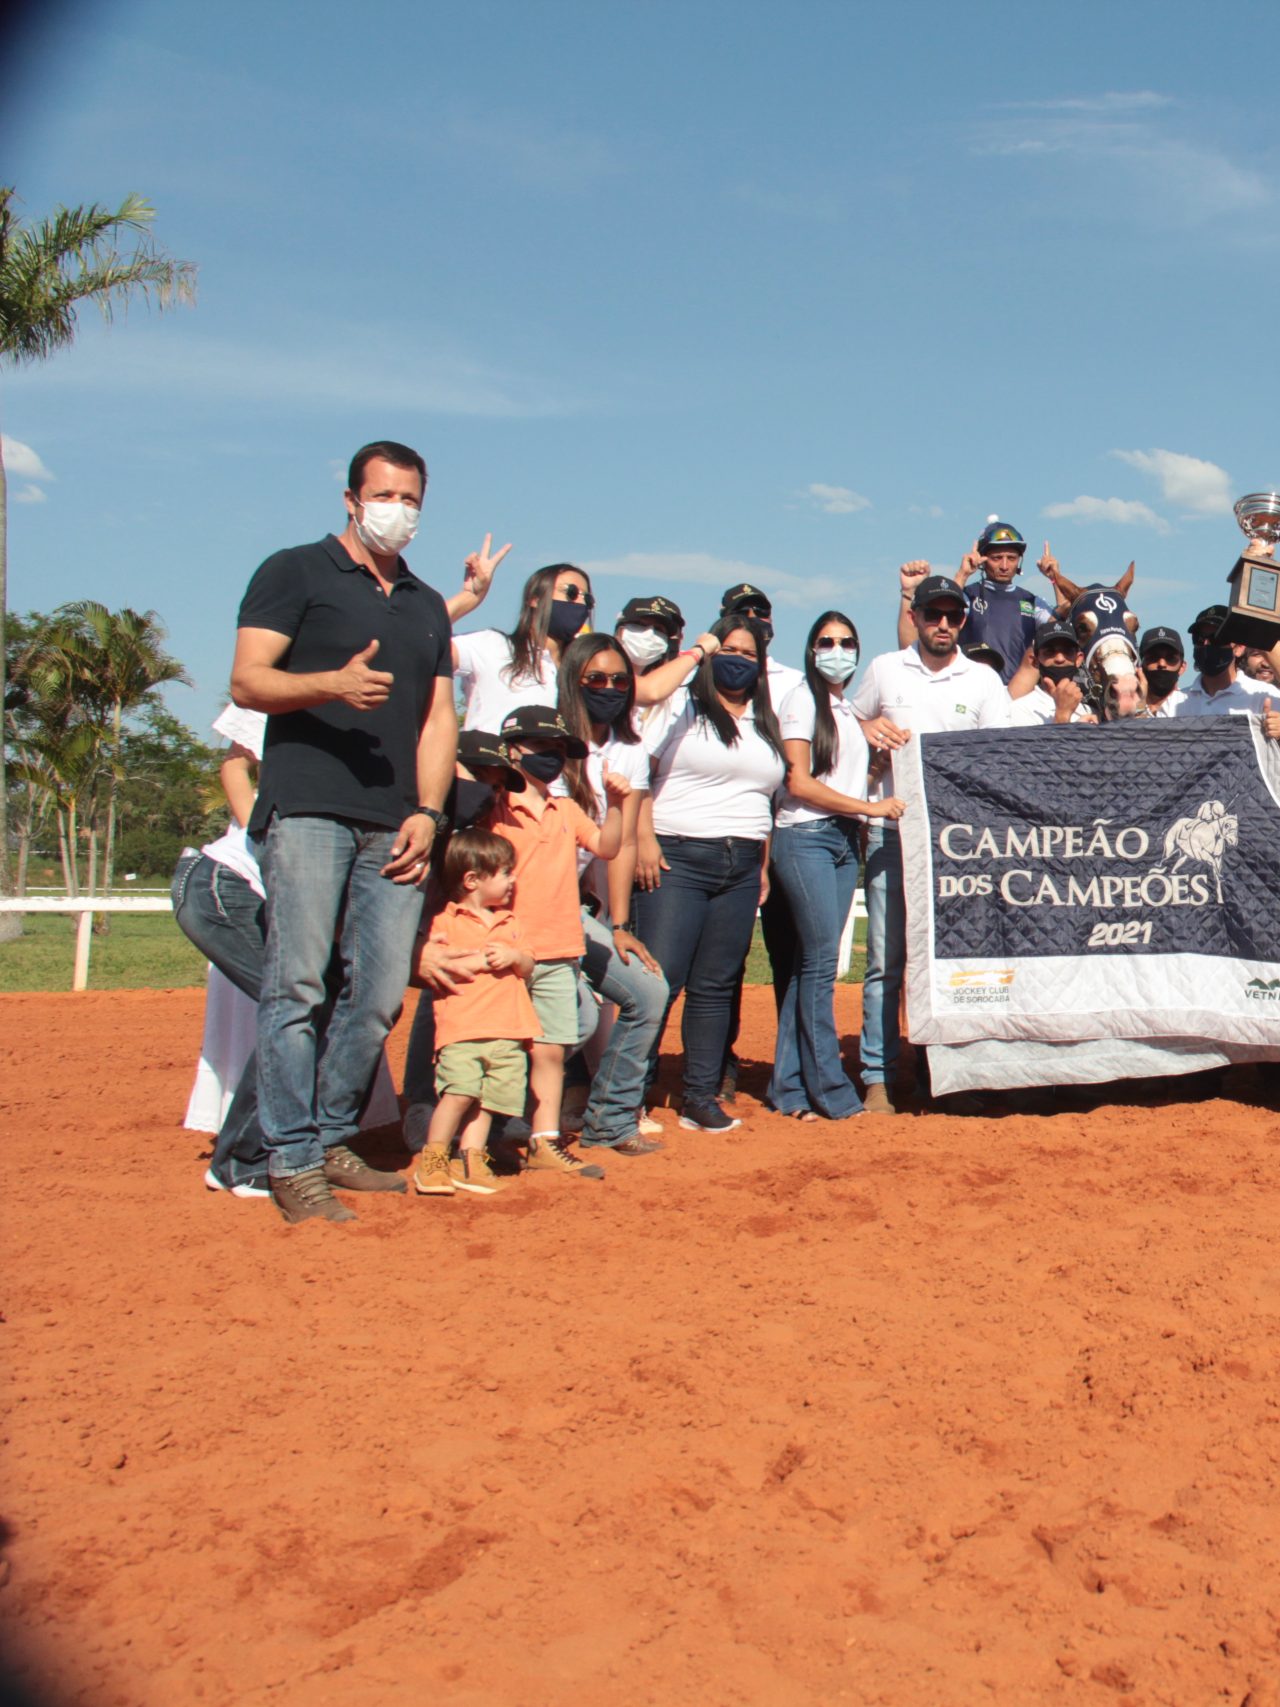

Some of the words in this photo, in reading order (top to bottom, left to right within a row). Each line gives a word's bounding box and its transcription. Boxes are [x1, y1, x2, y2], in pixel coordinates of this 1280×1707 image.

[938, 818, 1150, 861] CAMPEÃO
[938, 874, 994, 898] DOS
[1000, 866, 1210, 908] CAMPEÕES
[1087, 920, 1153, 947] 2021
[953, 986, 986, 996] JOCKEY
[988, 985, 1009, 994] CLUB
[953, 995, 965, 1004] DE
[966, 994, 1010, 1004] SOROCABA
